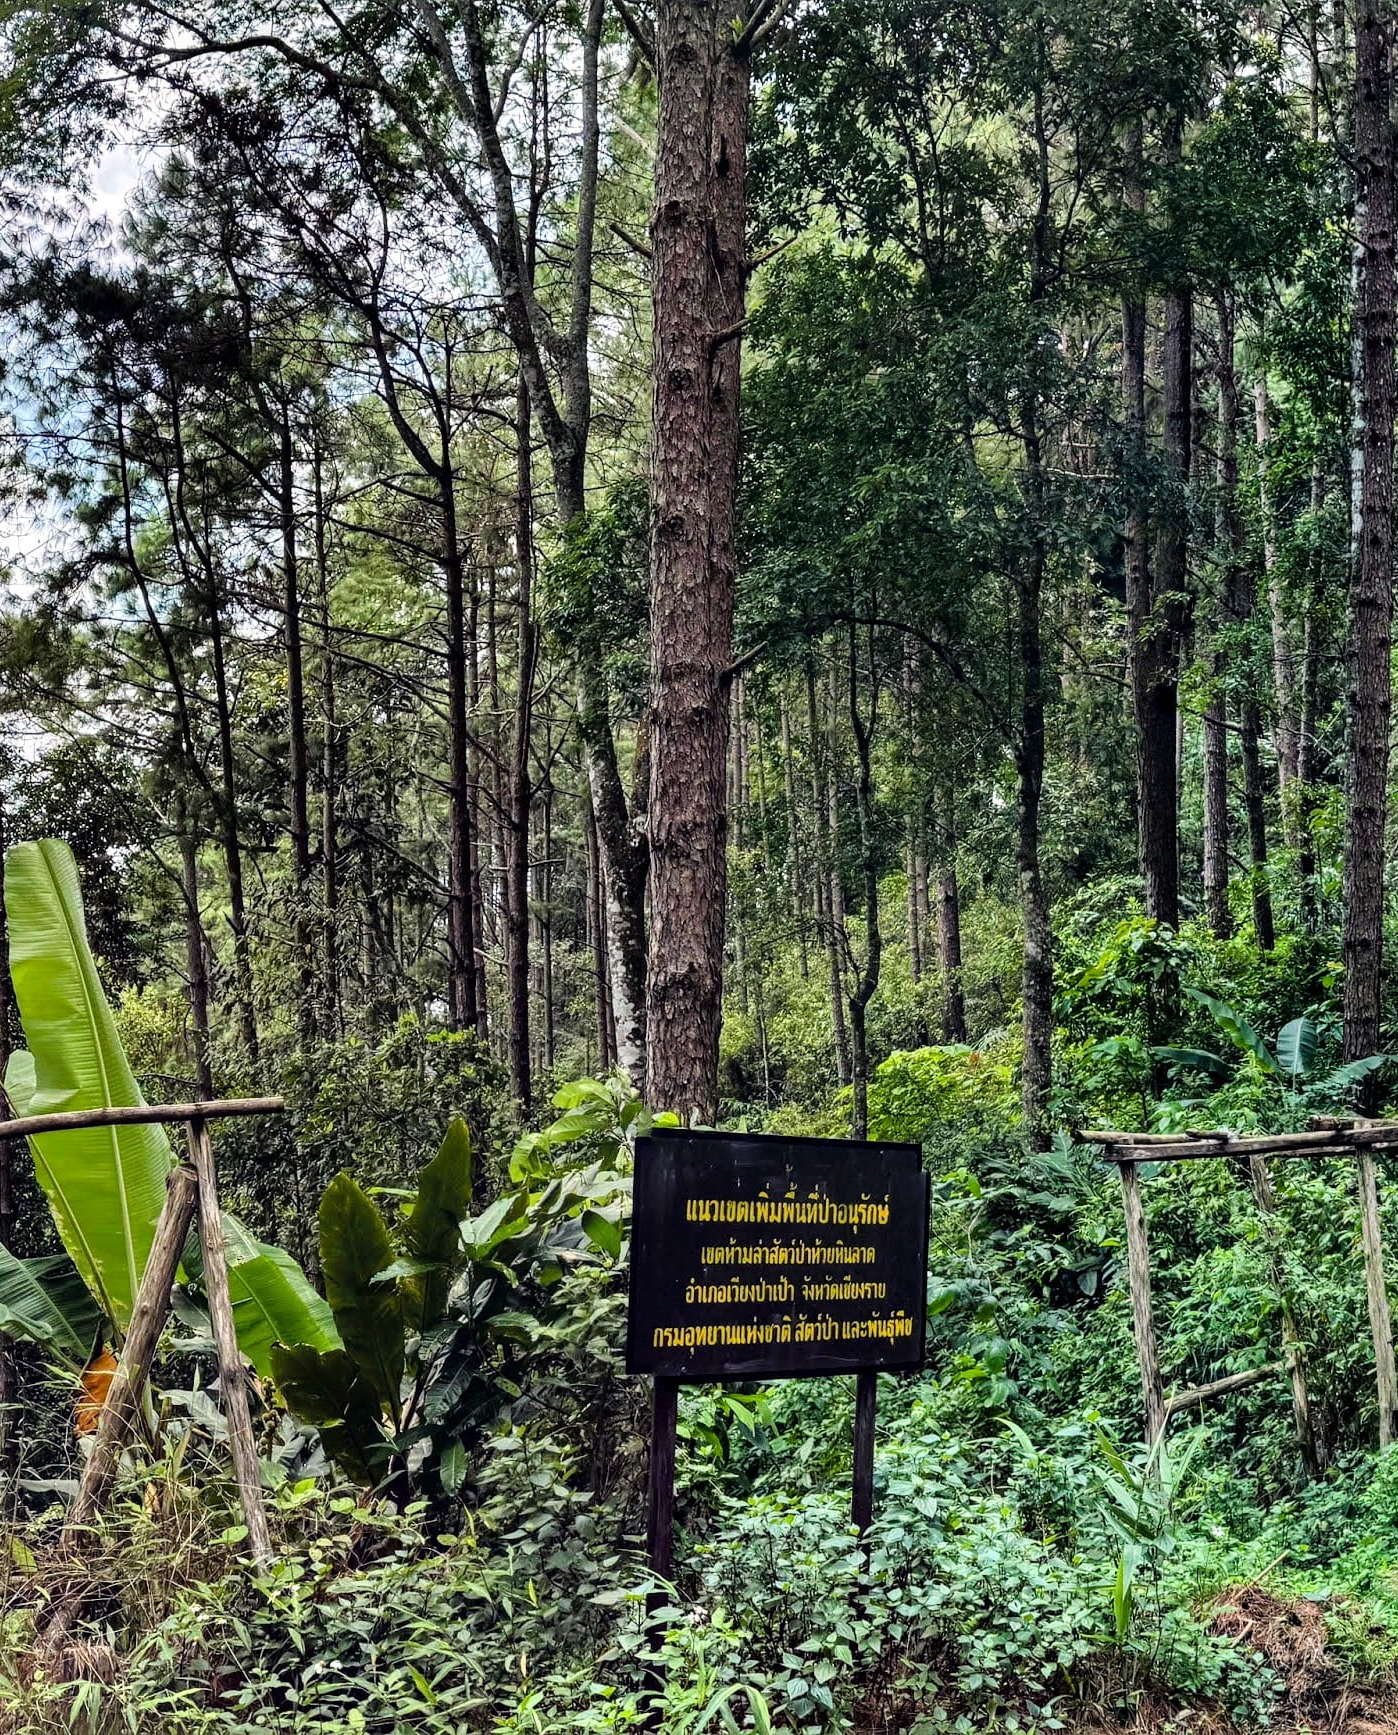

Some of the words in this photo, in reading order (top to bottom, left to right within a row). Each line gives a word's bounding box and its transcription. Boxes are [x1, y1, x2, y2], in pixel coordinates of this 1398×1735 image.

[686, 1182, 890, 1234] แนวเขตเพิ่มพื้นที่ป่าอนุรักษ์
[685, 1277, 795, 1304] อำเภอเวียงป่าเป้า
[801, 1276, 886, 1302] จังหวัดเชียงราย
[653, 1316, 792, 1354] กรมอุทยานแห่งชาติ
[794, 1313, 839, 1343] สัตว์ป่า
[842, 1310, 913, 1345] และพันธุ์พืช
